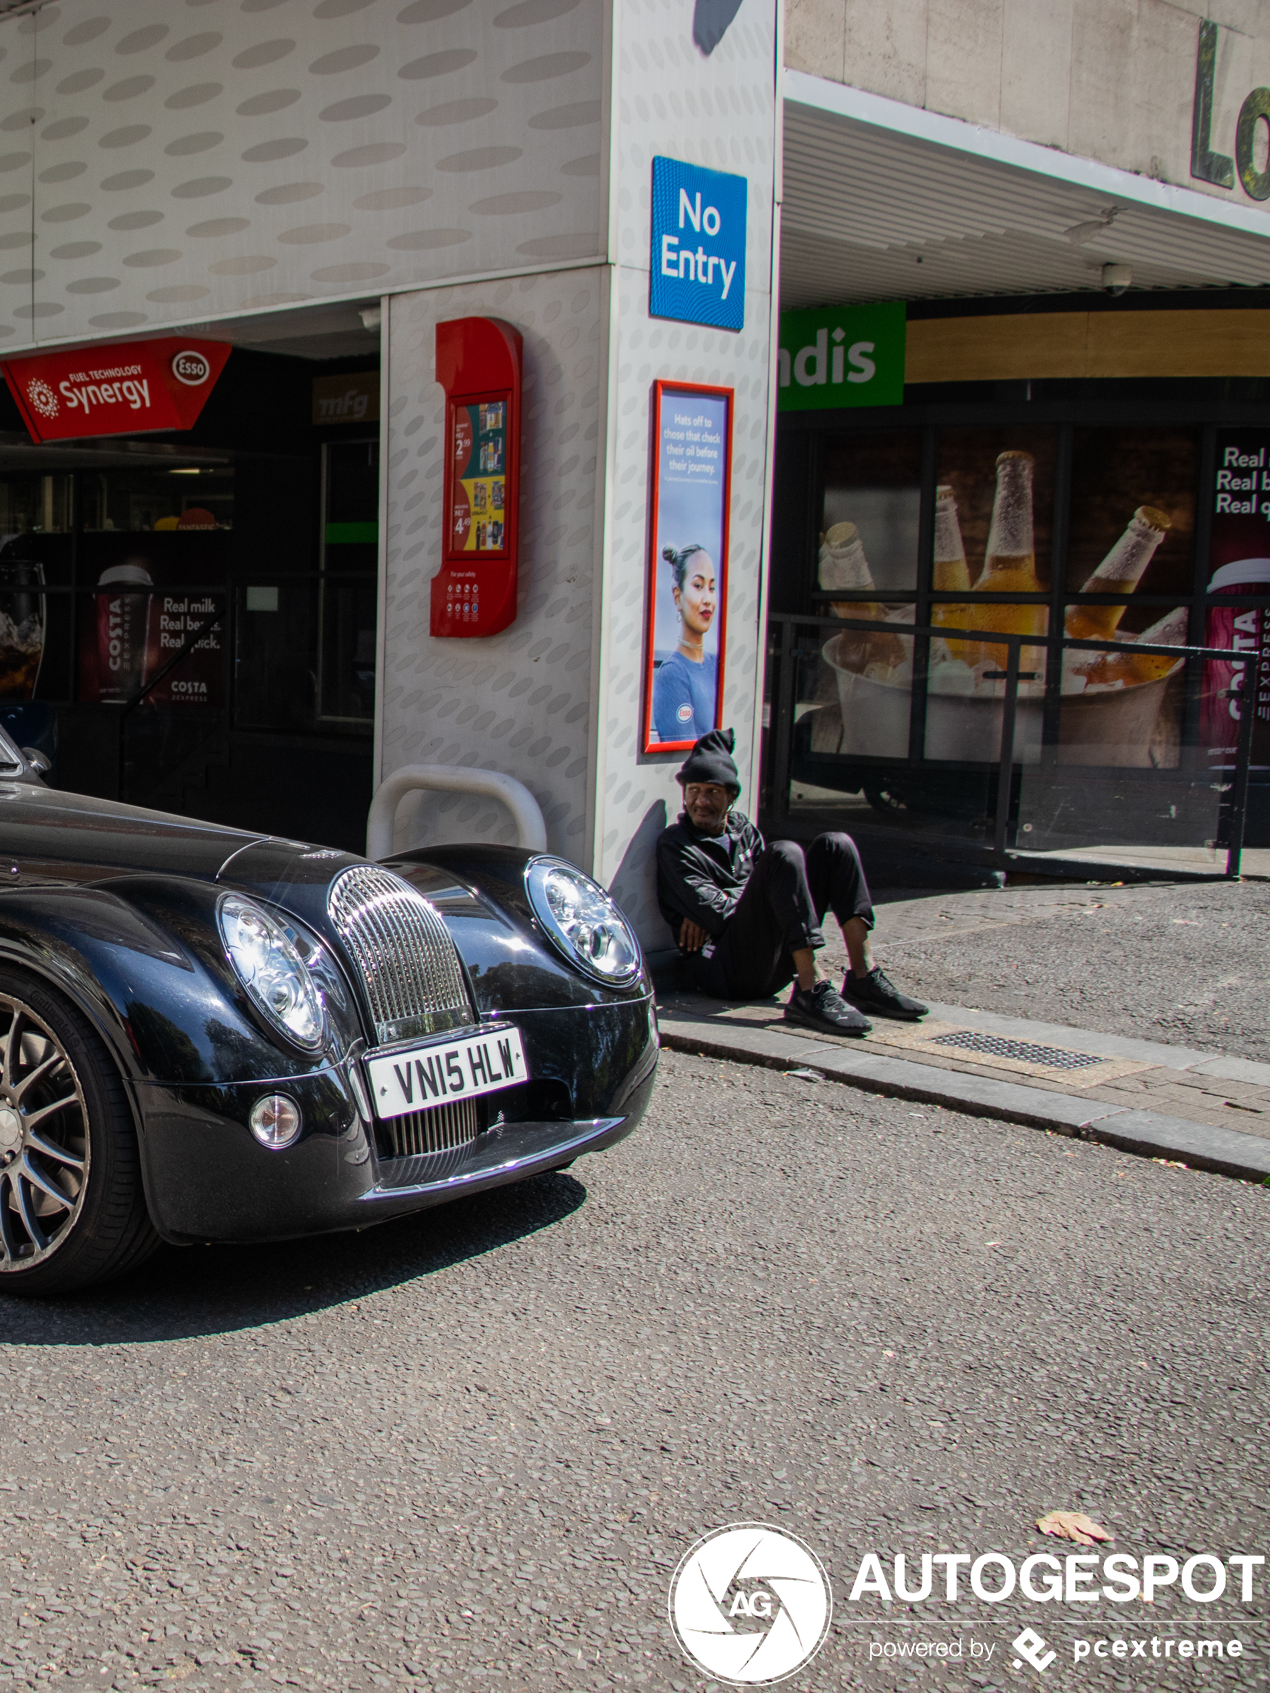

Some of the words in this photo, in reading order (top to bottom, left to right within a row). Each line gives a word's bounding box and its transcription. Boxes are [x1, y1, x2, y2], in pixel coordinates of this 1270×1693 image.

[679, 188, 721, 236] No
[662, 234, 737, 300] Entry
[68, 372, 90, 383] FUEL
[89, 364, 142, 381] TECHNOLOGY
[58, 378, 151, 415] Synergy
[674, 413, 692, 426] Hats
[692, 415, 704, 427] off
[704, 418, 712, 428] to
[663, 427, 685, 440] those
[686, 430, 701, 441] that
[701, 431, 720, 443] check
[666, 443, 684, 455] their
[685, 444, 695, 456] oil
[696, 446, 718, 458] before
[1223, 446, 1265, 468] Real
[669, 459, 688, 471] their
[687, 460, 716, 476] journey.
[1215, 469, 1258, 491] Real
[1215, 492, 1258, 514] Real
[163, 597, 188, 613] Real
[190, 597, 216, 613] milk
[160, 614, 184, 630] Real
[186, 616, 222, 631] bes.
[109, 598, 122, 671] COSTA
[160, 632, 185, 648] Real
[1229, 609, 1259, 721] CTA
[171, 681, 208, 694] COSTA
[679, 708, 691, 717] Esso
[393, 1051, 465, 1104] VN15
[467, 1038, 515, 1087] HLW
